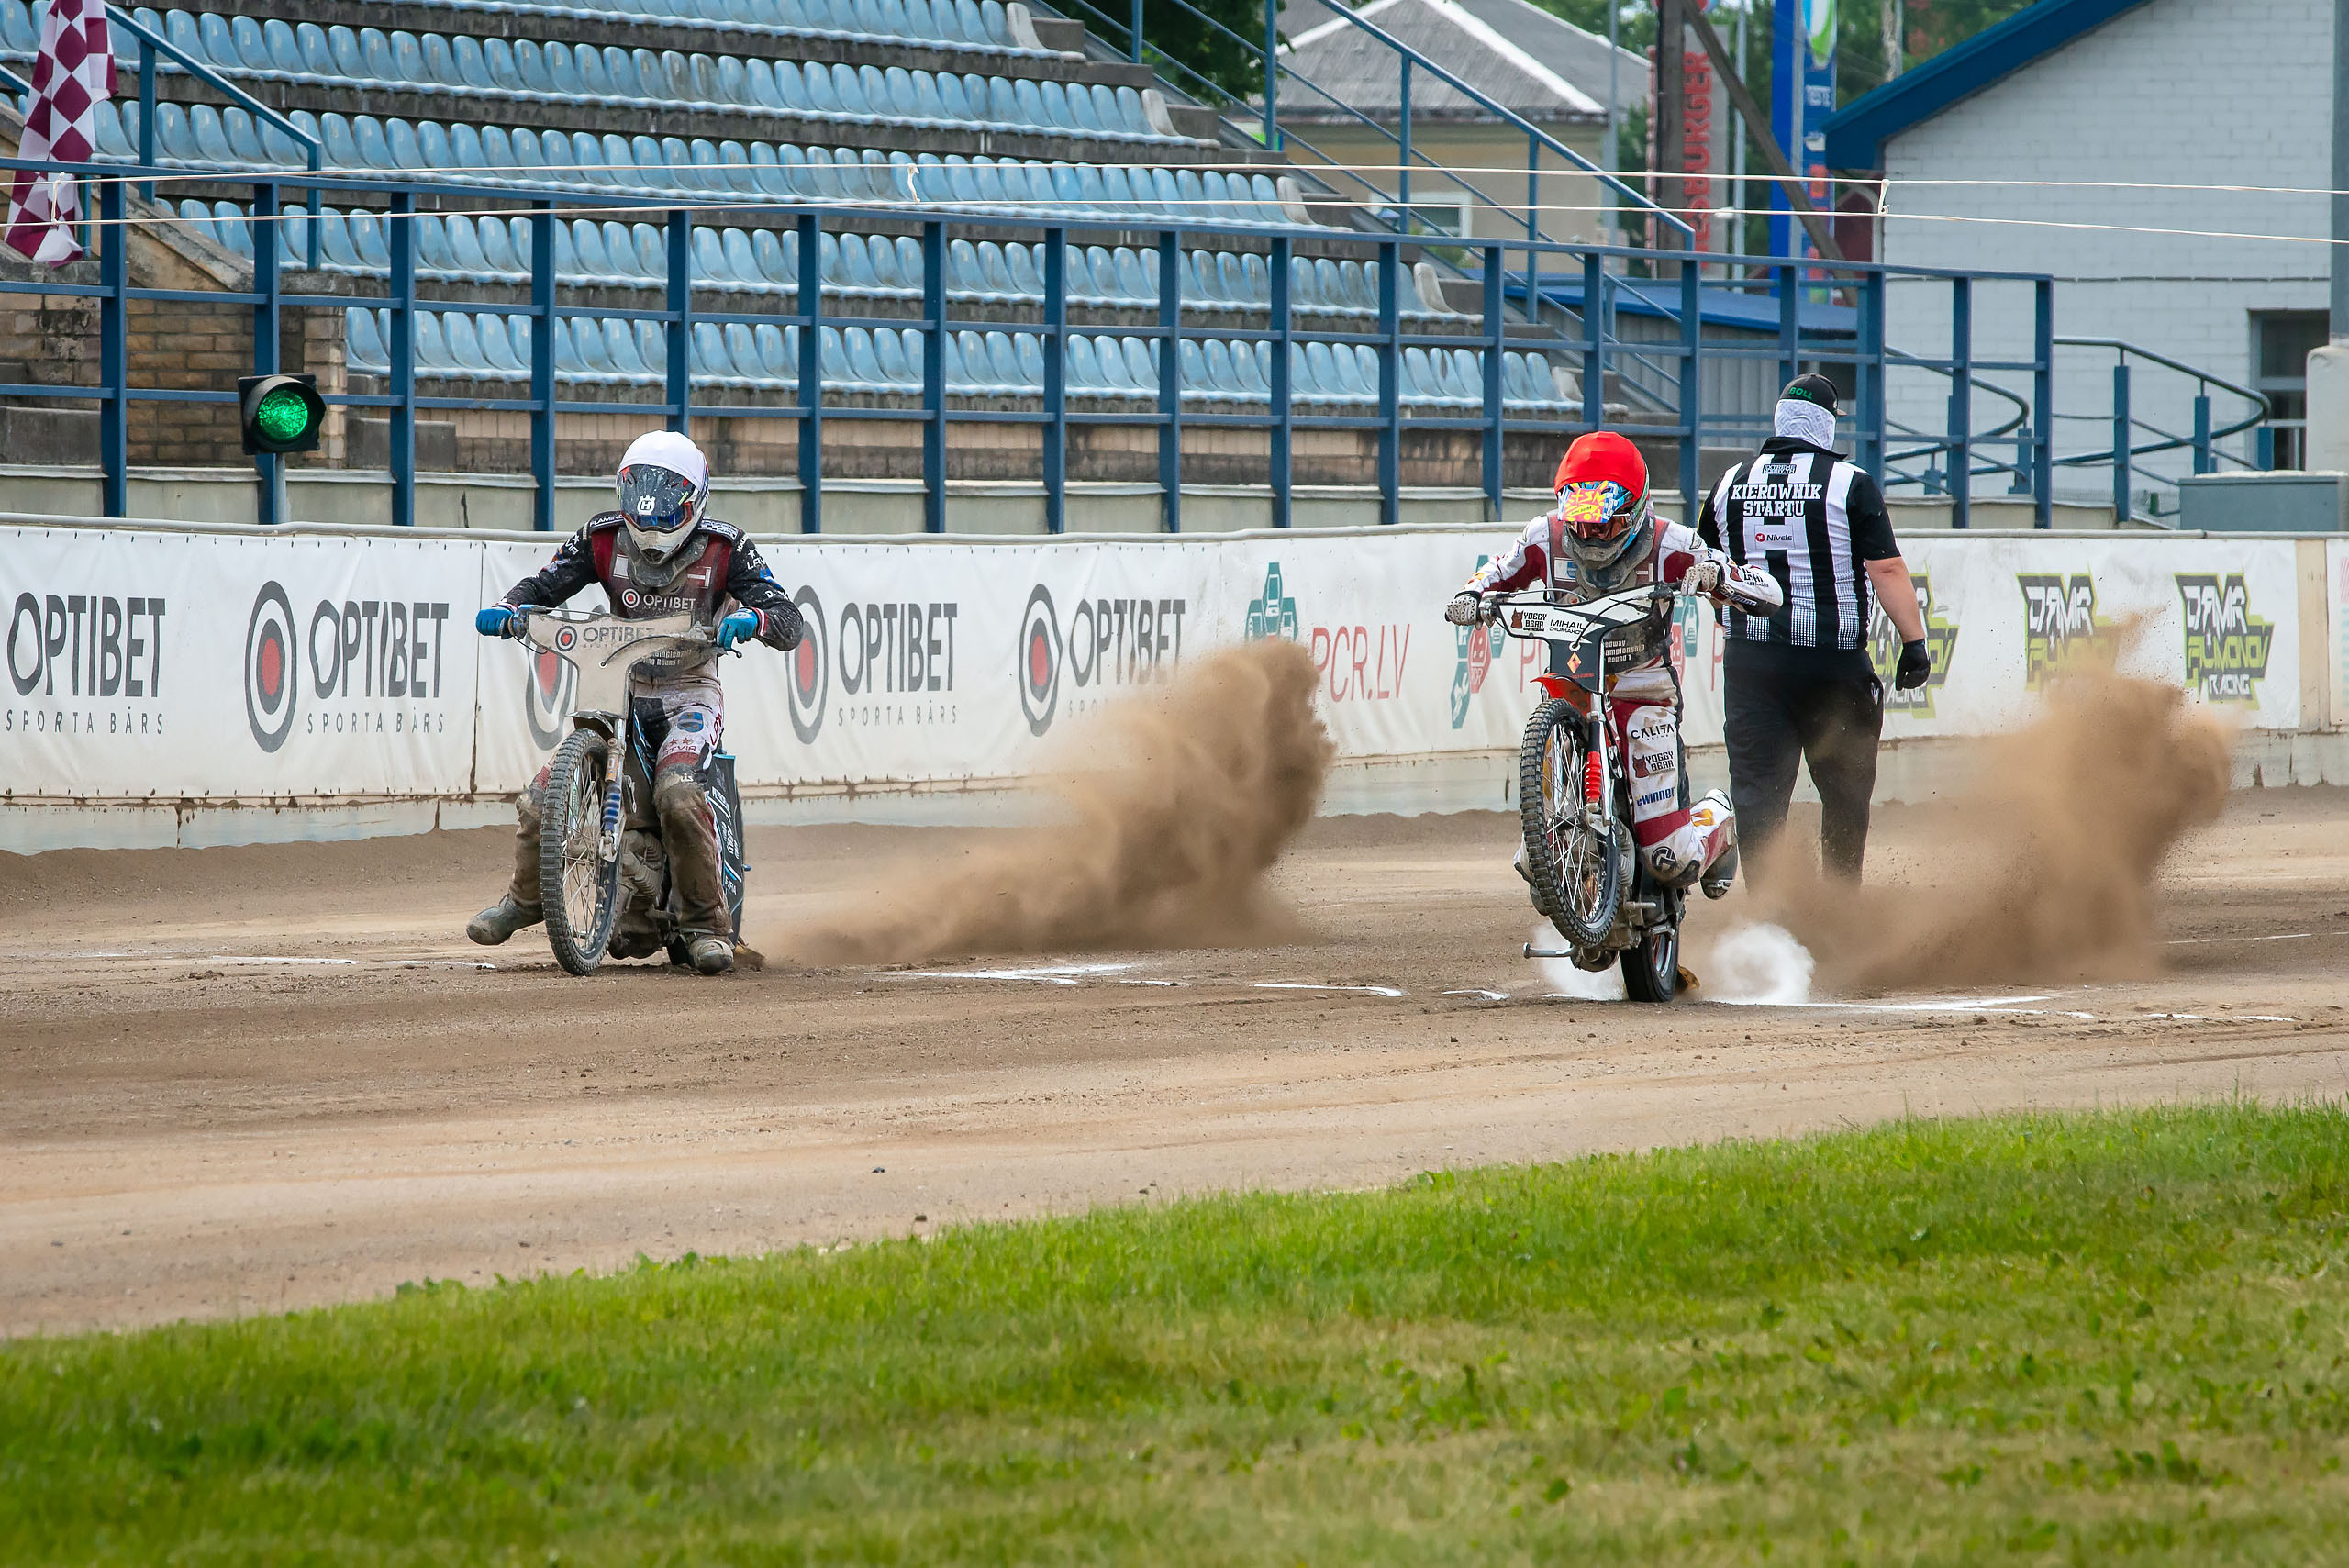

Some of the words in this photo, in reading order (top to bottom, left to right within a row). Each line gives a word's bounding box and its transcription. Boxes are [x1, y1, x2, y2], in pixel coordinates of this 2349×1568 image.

[1731, 484, 1823, 500] KIEROWNIK
[1743, 500, 1805, 517] STARTU
[1766, 533, 1793, 541] Nivels
[643, 594, 696, 610] OPTIBET
[1523, 612, 1547, 621] YOGGY
[1550, 619, 1585, 630] MIHAIL
[583, 626, 654, 643] OPTIBET
[1069, 598, 1186, 687] OPTIBET
[7, 592, 166, 698] OPTIBET
[308, 599, 450, 699] OPTIBET
[839, 602, 958, 695] OPTIBET
[1312, 624, 1411, 703] PCR.LV
[1607, 654, 1627, 663] Round
[6, 709, 95, 734] SPORTA
[109, 706, 163, 734] BĀRS
[308, 711, 383, 734] SPORTA
[838, 705, 904, 727] SPORTA
[1645, 751, 1674, 764] YOGGY
[1651, 760, 1675, 772] BEAR
